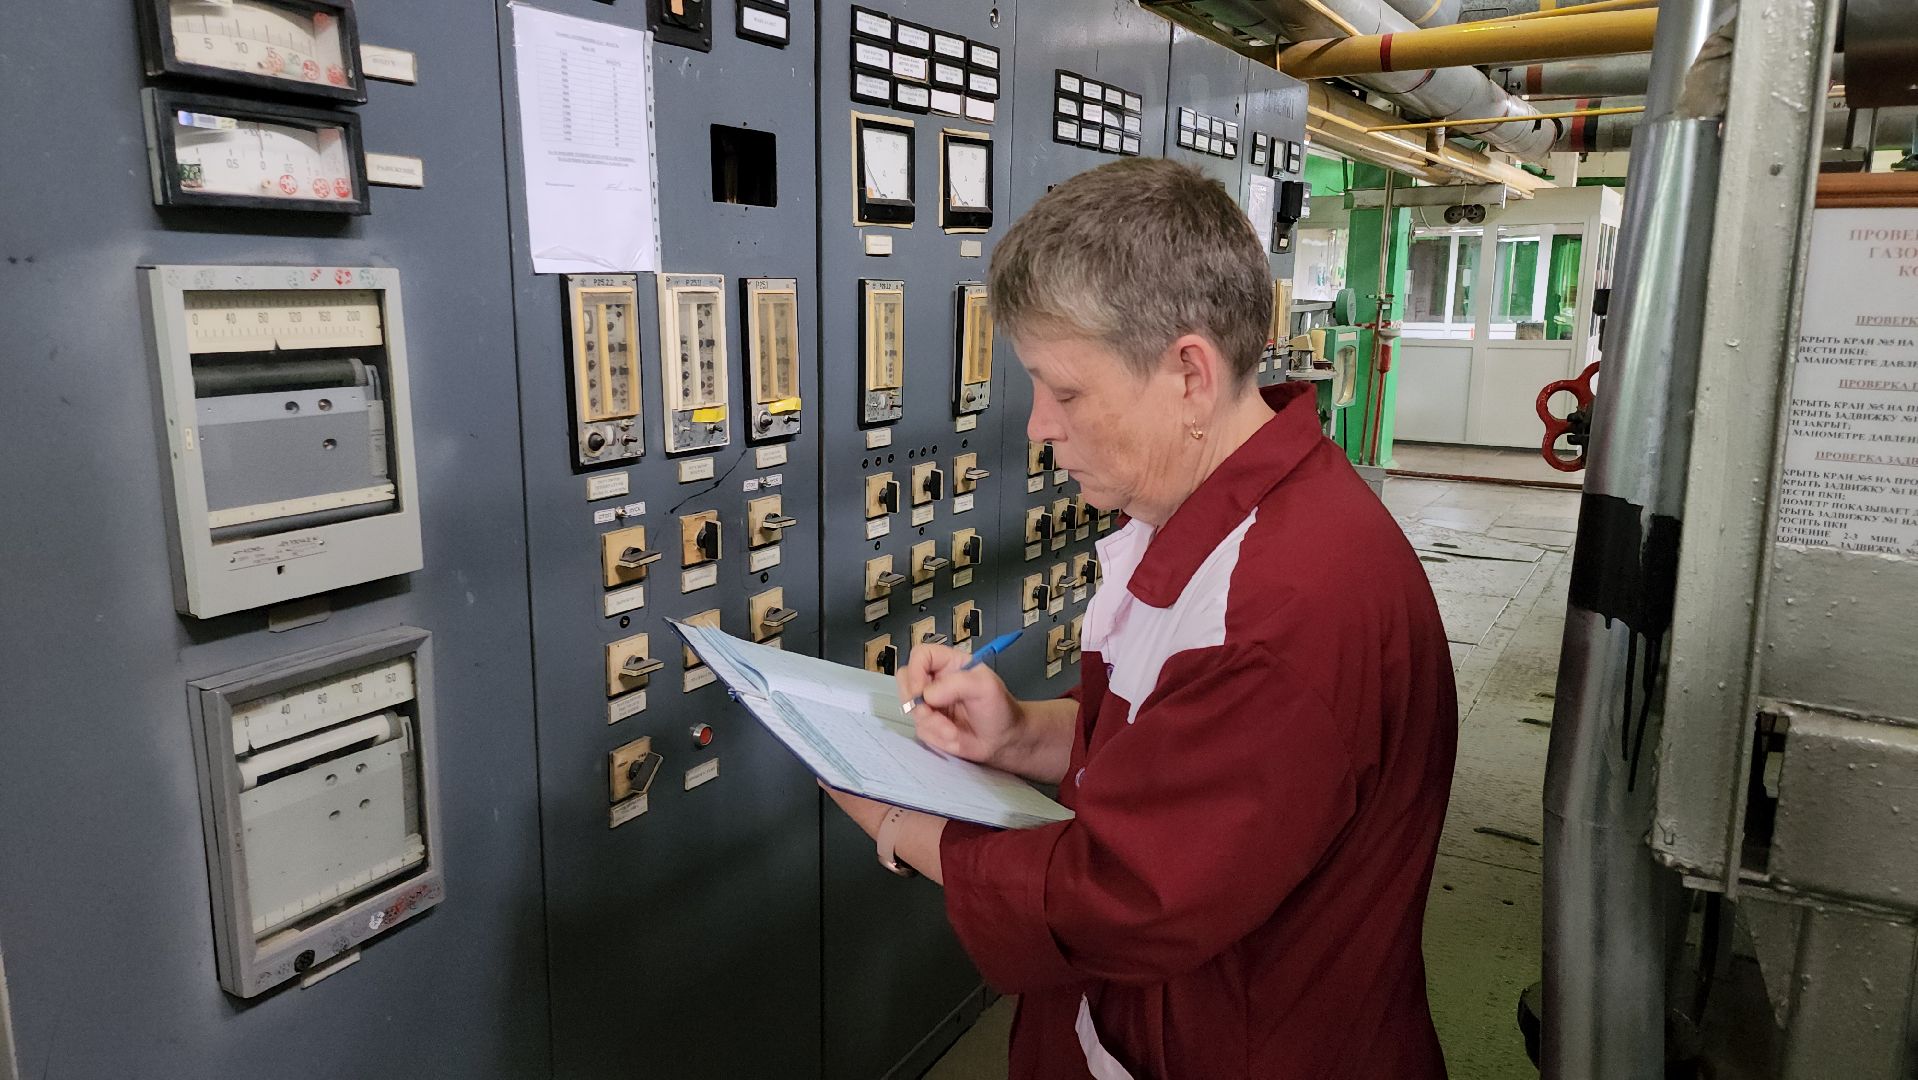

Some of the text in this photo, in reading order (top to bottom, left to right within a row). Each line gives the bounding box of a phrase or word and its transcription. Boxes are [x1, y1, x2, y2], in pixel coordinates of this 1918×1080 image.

[203, 37, 214, 50] 5
[234, 41, 249, 54] 10
[1848, 228, 1918, 241] ПРОВЕ
[191, 312, 199, 326] 0
[225, 311, 237, 325] 40
[288, 311, 302, 323] 120
[318, 310, 332, 322] 160
[346, 310, 361, 322] 200
[1843, 337, 1875, 345] КРАН
[1897, 339, 1914, 347] НА
[1803, 356, 1877, 367] МАНОМЕТРЕ
[1838, 379, 1908, 391] ПРОВЕРКА
[1833, 401, 1865, 410] КРАН
[1887, 404, 1903, 412] НА
[1835, 411, 1898, 422] ЗАДВИЖКУ
[1793, 429, 1866, 441] МАНОМЕТРЕ
[1814, 450, 1883, 464] ПРОВЕРКА
[1823, 471, 1853, 481] КРАН
[1875, 476, 1891, 484] НА
[1824, 481, 1886, 493] ЗАДВИЖКУ
[1832, 502, 1911, 515] ПОКАЗЫВАЕТ
[1818, 510, 1881, 522] ЗАДВИЖКУ
[1781, 526, 1832, 538] ТЕЧЕНИЕ
[244, 715, 250, 727] 0
[281, 703, 290, 714] 40
[351, 682, 363, 694] 120
